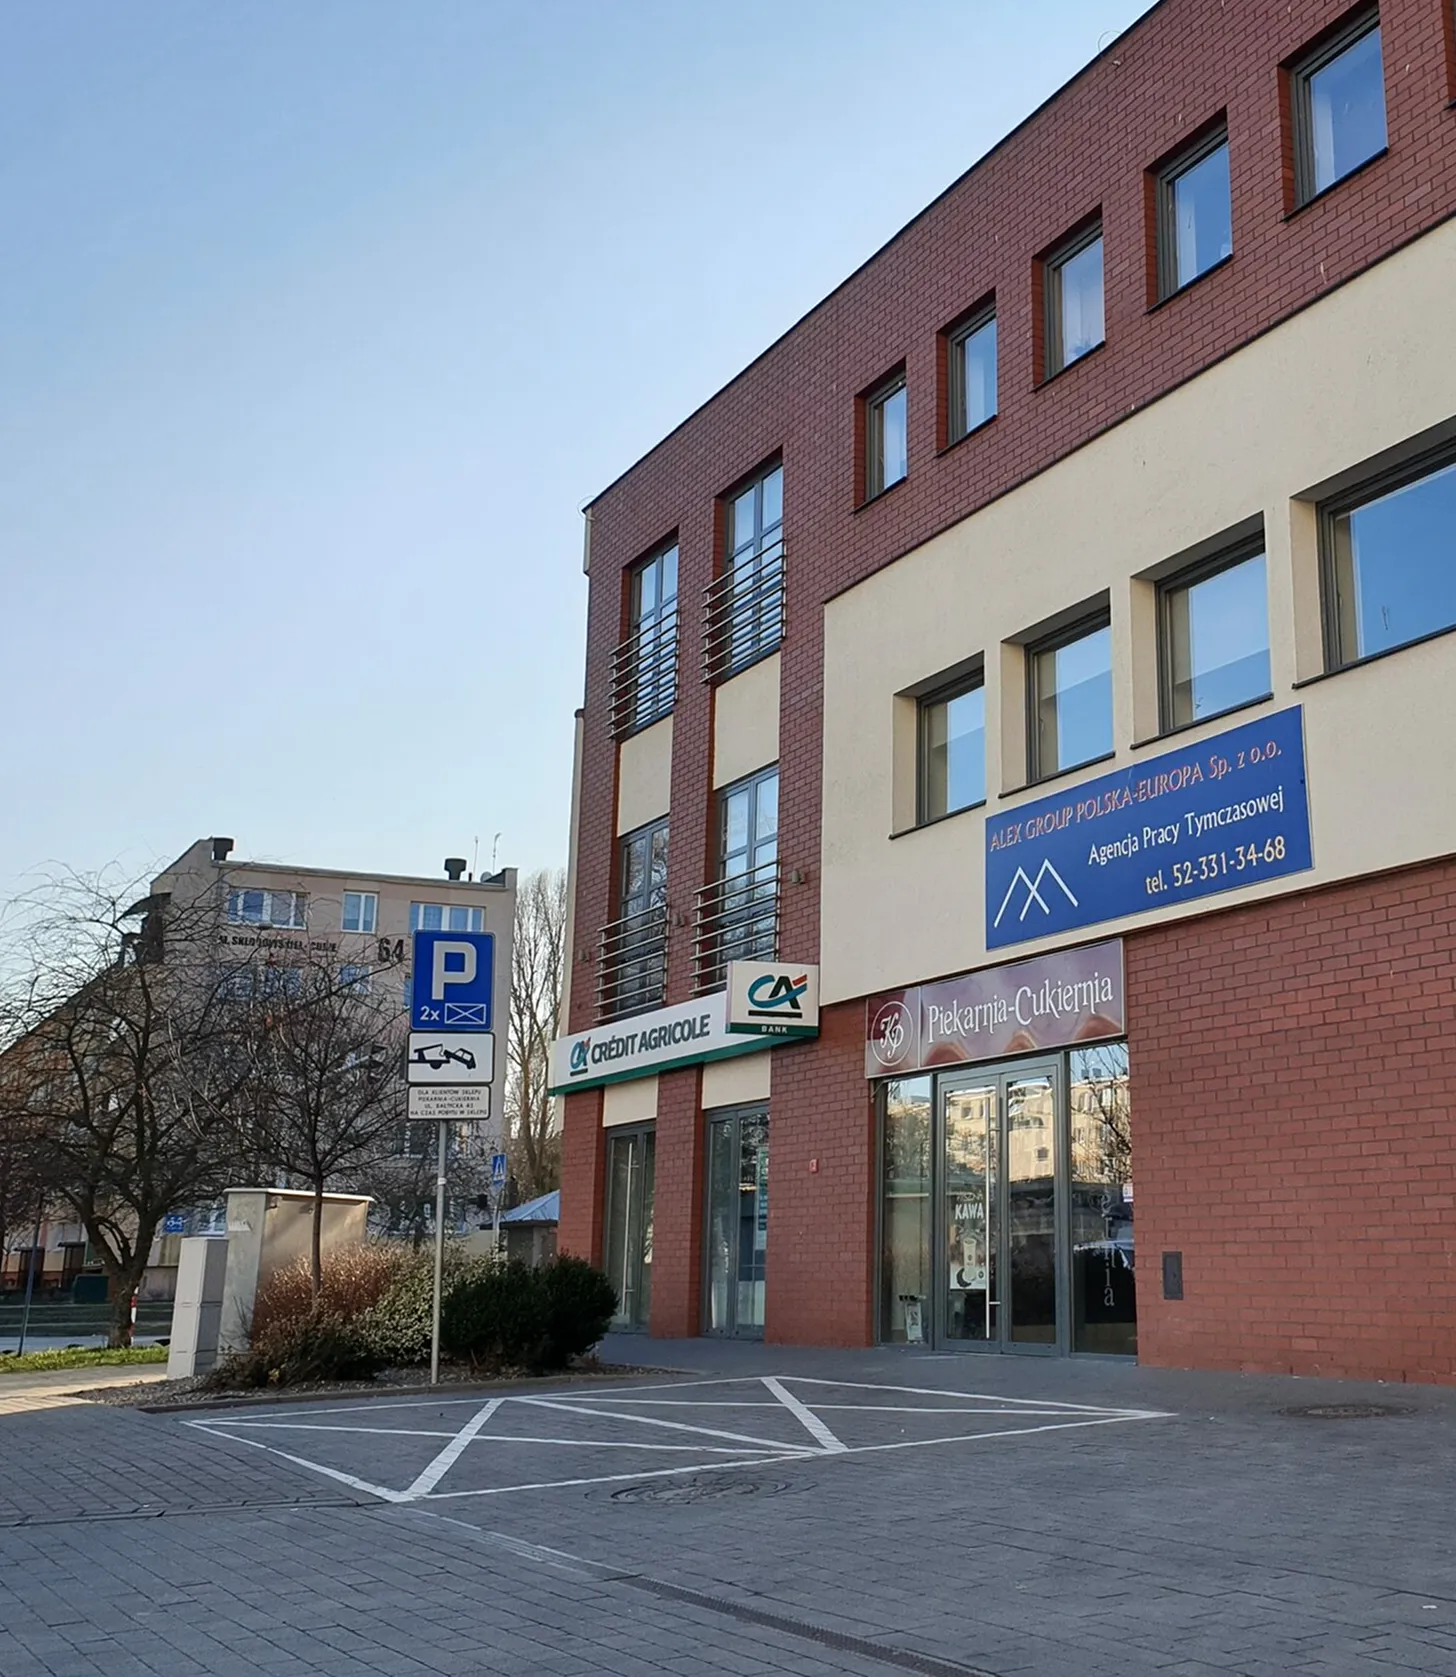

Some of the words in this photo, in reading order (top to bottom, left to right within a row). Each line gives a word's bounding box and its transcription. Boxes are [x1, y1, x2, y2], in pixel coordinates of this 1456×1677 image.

[990, 823, 1022, 852] ALEX
[1025, 806, 1073, 840] GROUP
[1076, 762, 1204, 824] POLSKA-EUROPA
[1208, 755, 1232, 780] Sp.
[1237, 751, 1245, 769] z
[1250, 740, 1282, 764] o.o.
[1088, 832, 1139, 866] Agencja
[1143, 822, 1180, 849] Pracy
[1184, 785, 1284, 838] Tymczasowej
[1145, 869, 1168, 894] tel.
[1173, 835, 1286, 888] 52-331-34-68
[377, 937, 405, 962] 64
[431, 940, 477, 1000] P
[419, 1006, 440, 1021] 2x
[761, 1025, 788, 1034] BANK
[927, 972, 1114, 1043] Piekarnia-Cukiernia
[591, 1033, 639, 1065] CRÉDIT
[637, 1014, 711, 1054] AGRICOLE
[955, 1203, 984, 1220] KAWA
